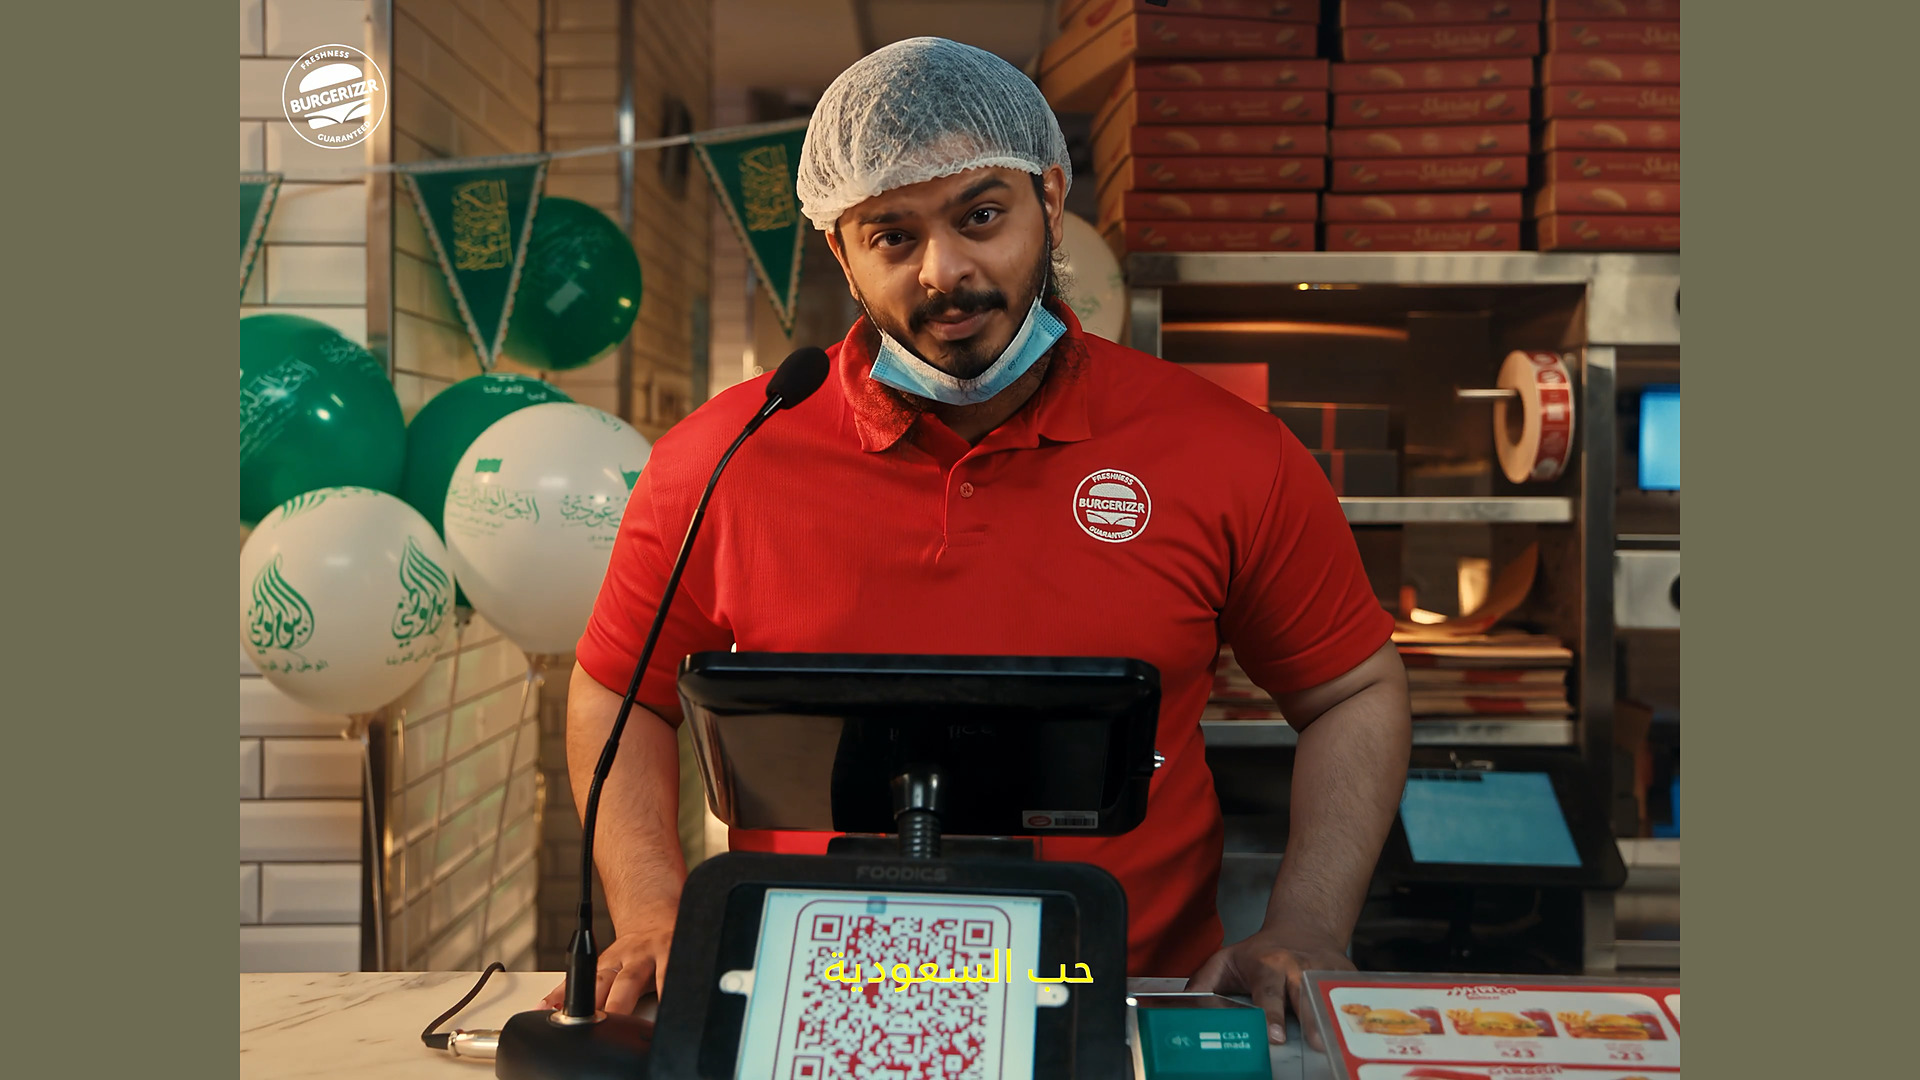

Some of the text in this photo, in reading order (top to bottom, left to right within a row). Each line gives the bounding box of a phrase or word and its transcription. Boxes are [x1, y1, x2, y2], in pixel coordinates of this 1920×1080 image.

[1092, 473, 1134, 486] FRESHNESS
[1078, 497, 1146, 514] BURGERIZZR
[1088, 525, 1134, 539] GUARANTEED
[1223, 1040, 1251, 1050] mada
